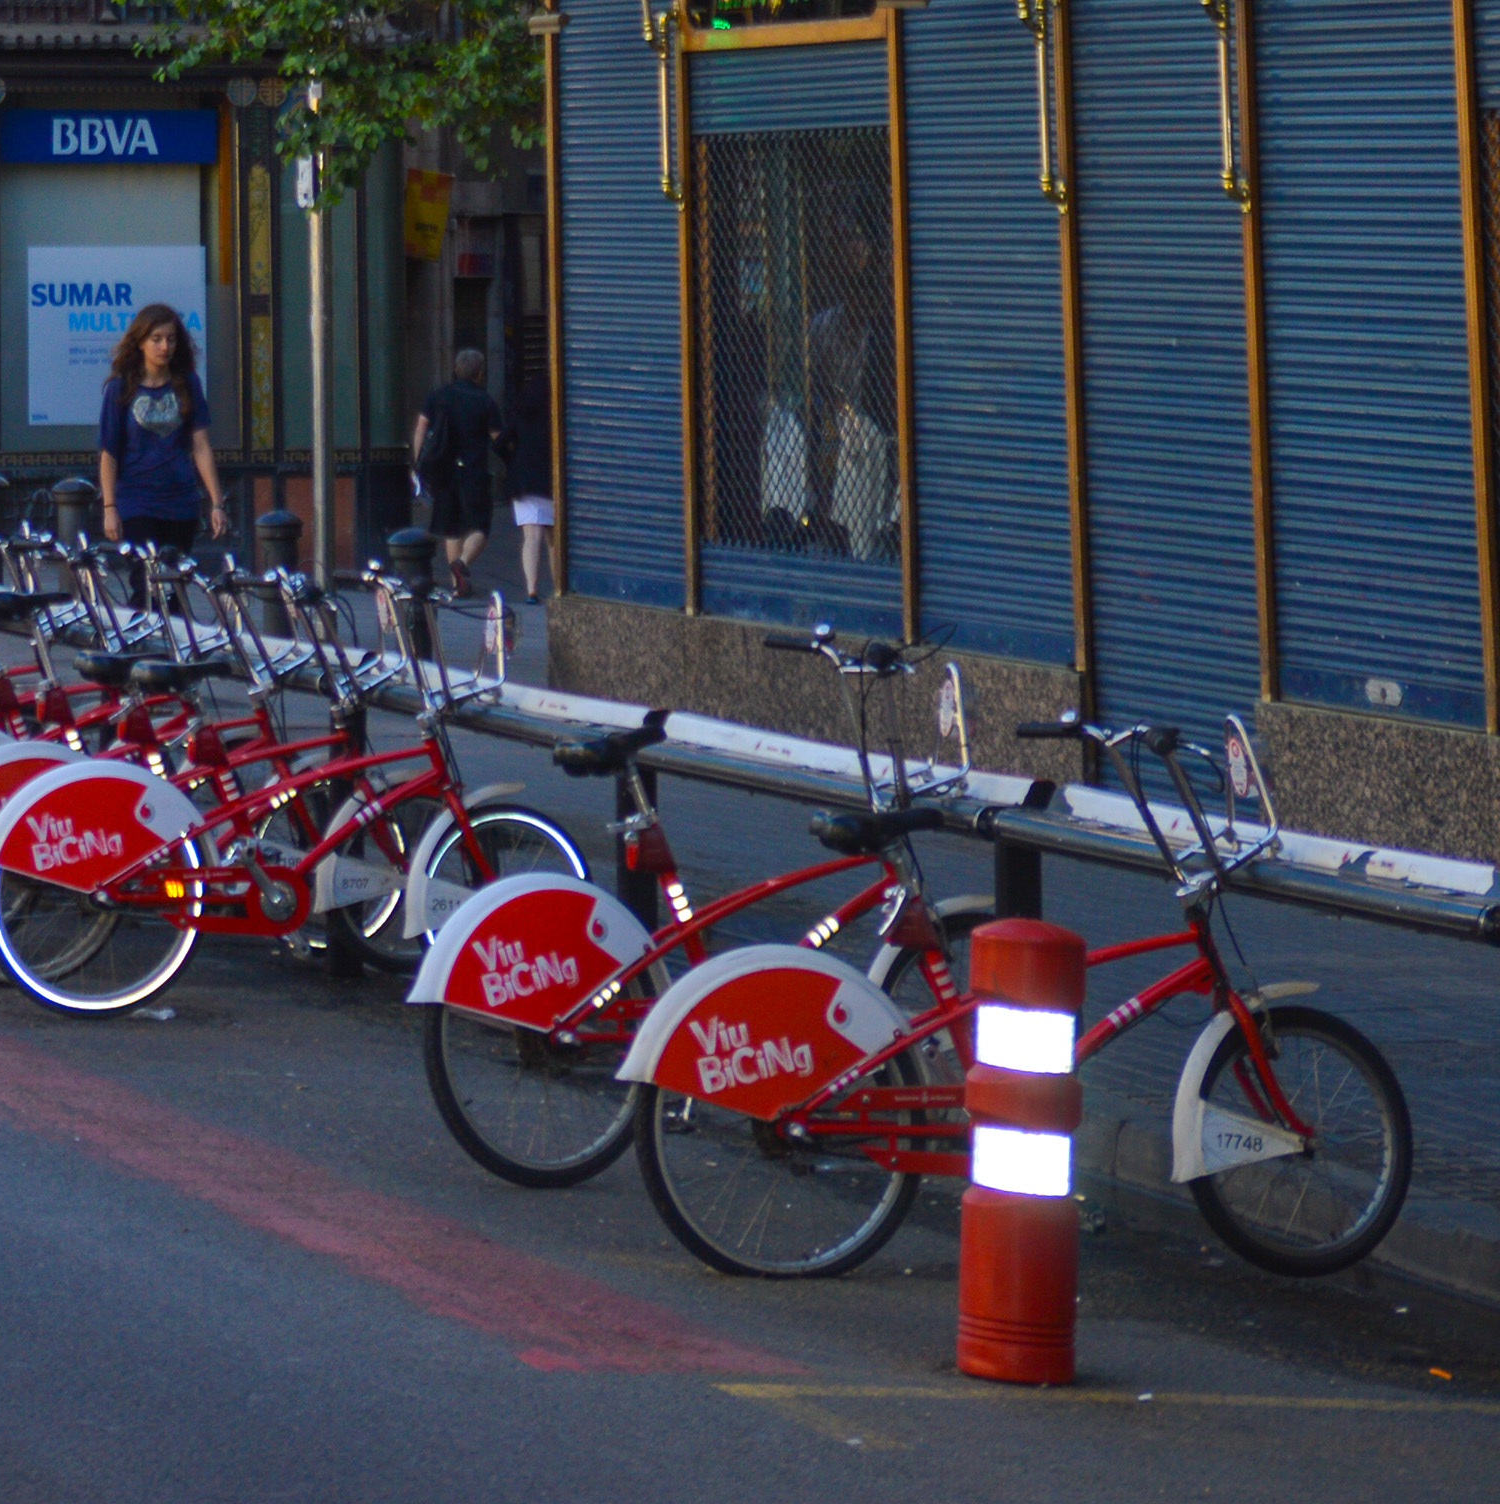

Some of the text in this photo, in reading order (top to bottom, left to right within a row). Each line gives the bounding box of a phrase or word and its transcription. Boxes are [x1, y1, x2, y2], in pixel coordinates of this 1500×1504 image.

[52, 118, 159, 155] BBVA
[30, 282, 133, 307] SUMAR
[25, 812, 74, 843] Viu
[32, 827, 124, 872] BiCiNg
[471, 935, 525, 972] Viu
[480, 950, 580, 1008] BiCiNg
[688, 1015, 749, 1055] Viu
[697, 1036, 814, 1094] BiCiNg
[1217, 1133, 1263, 1152] 17748
